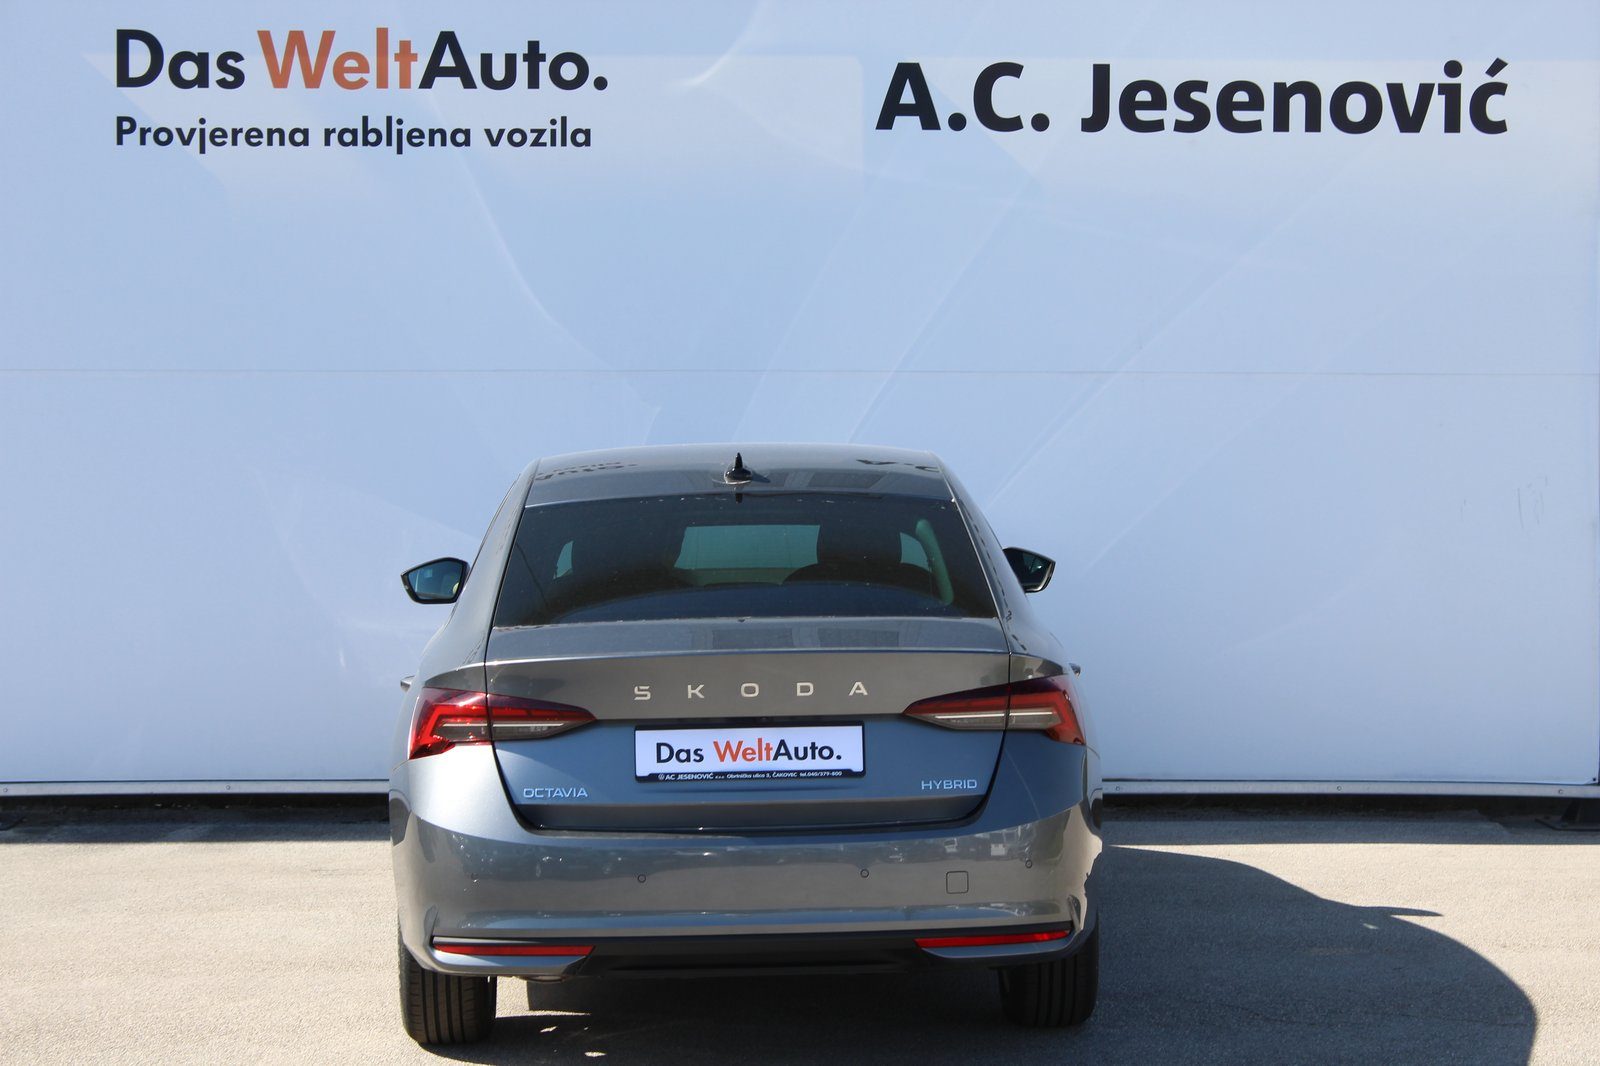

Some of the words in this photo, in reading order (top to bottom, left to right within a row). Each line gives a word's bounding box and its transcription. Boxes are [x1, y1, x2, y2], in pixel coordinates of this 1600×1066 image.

[116, 29, 245, 90] Das
[257, 27, 609, 91] WeltAuto.
[875, 61, 1050, 133] A.C.
[1080, 57, 1509, 135] Jesenović
[116, 115, 310, 155] Provjerena
[323, 115, 471, 155] rabljena
[484, 115, 591, 148] vozila
[656, 742, 704, 763] Das
[713, 737, 842, 763] WeltAuto.
[665, 773, 676, 781] AC
[921, 779, 978, 790] HYBRID
[523, 787, 588, 798] OCTAVIA
